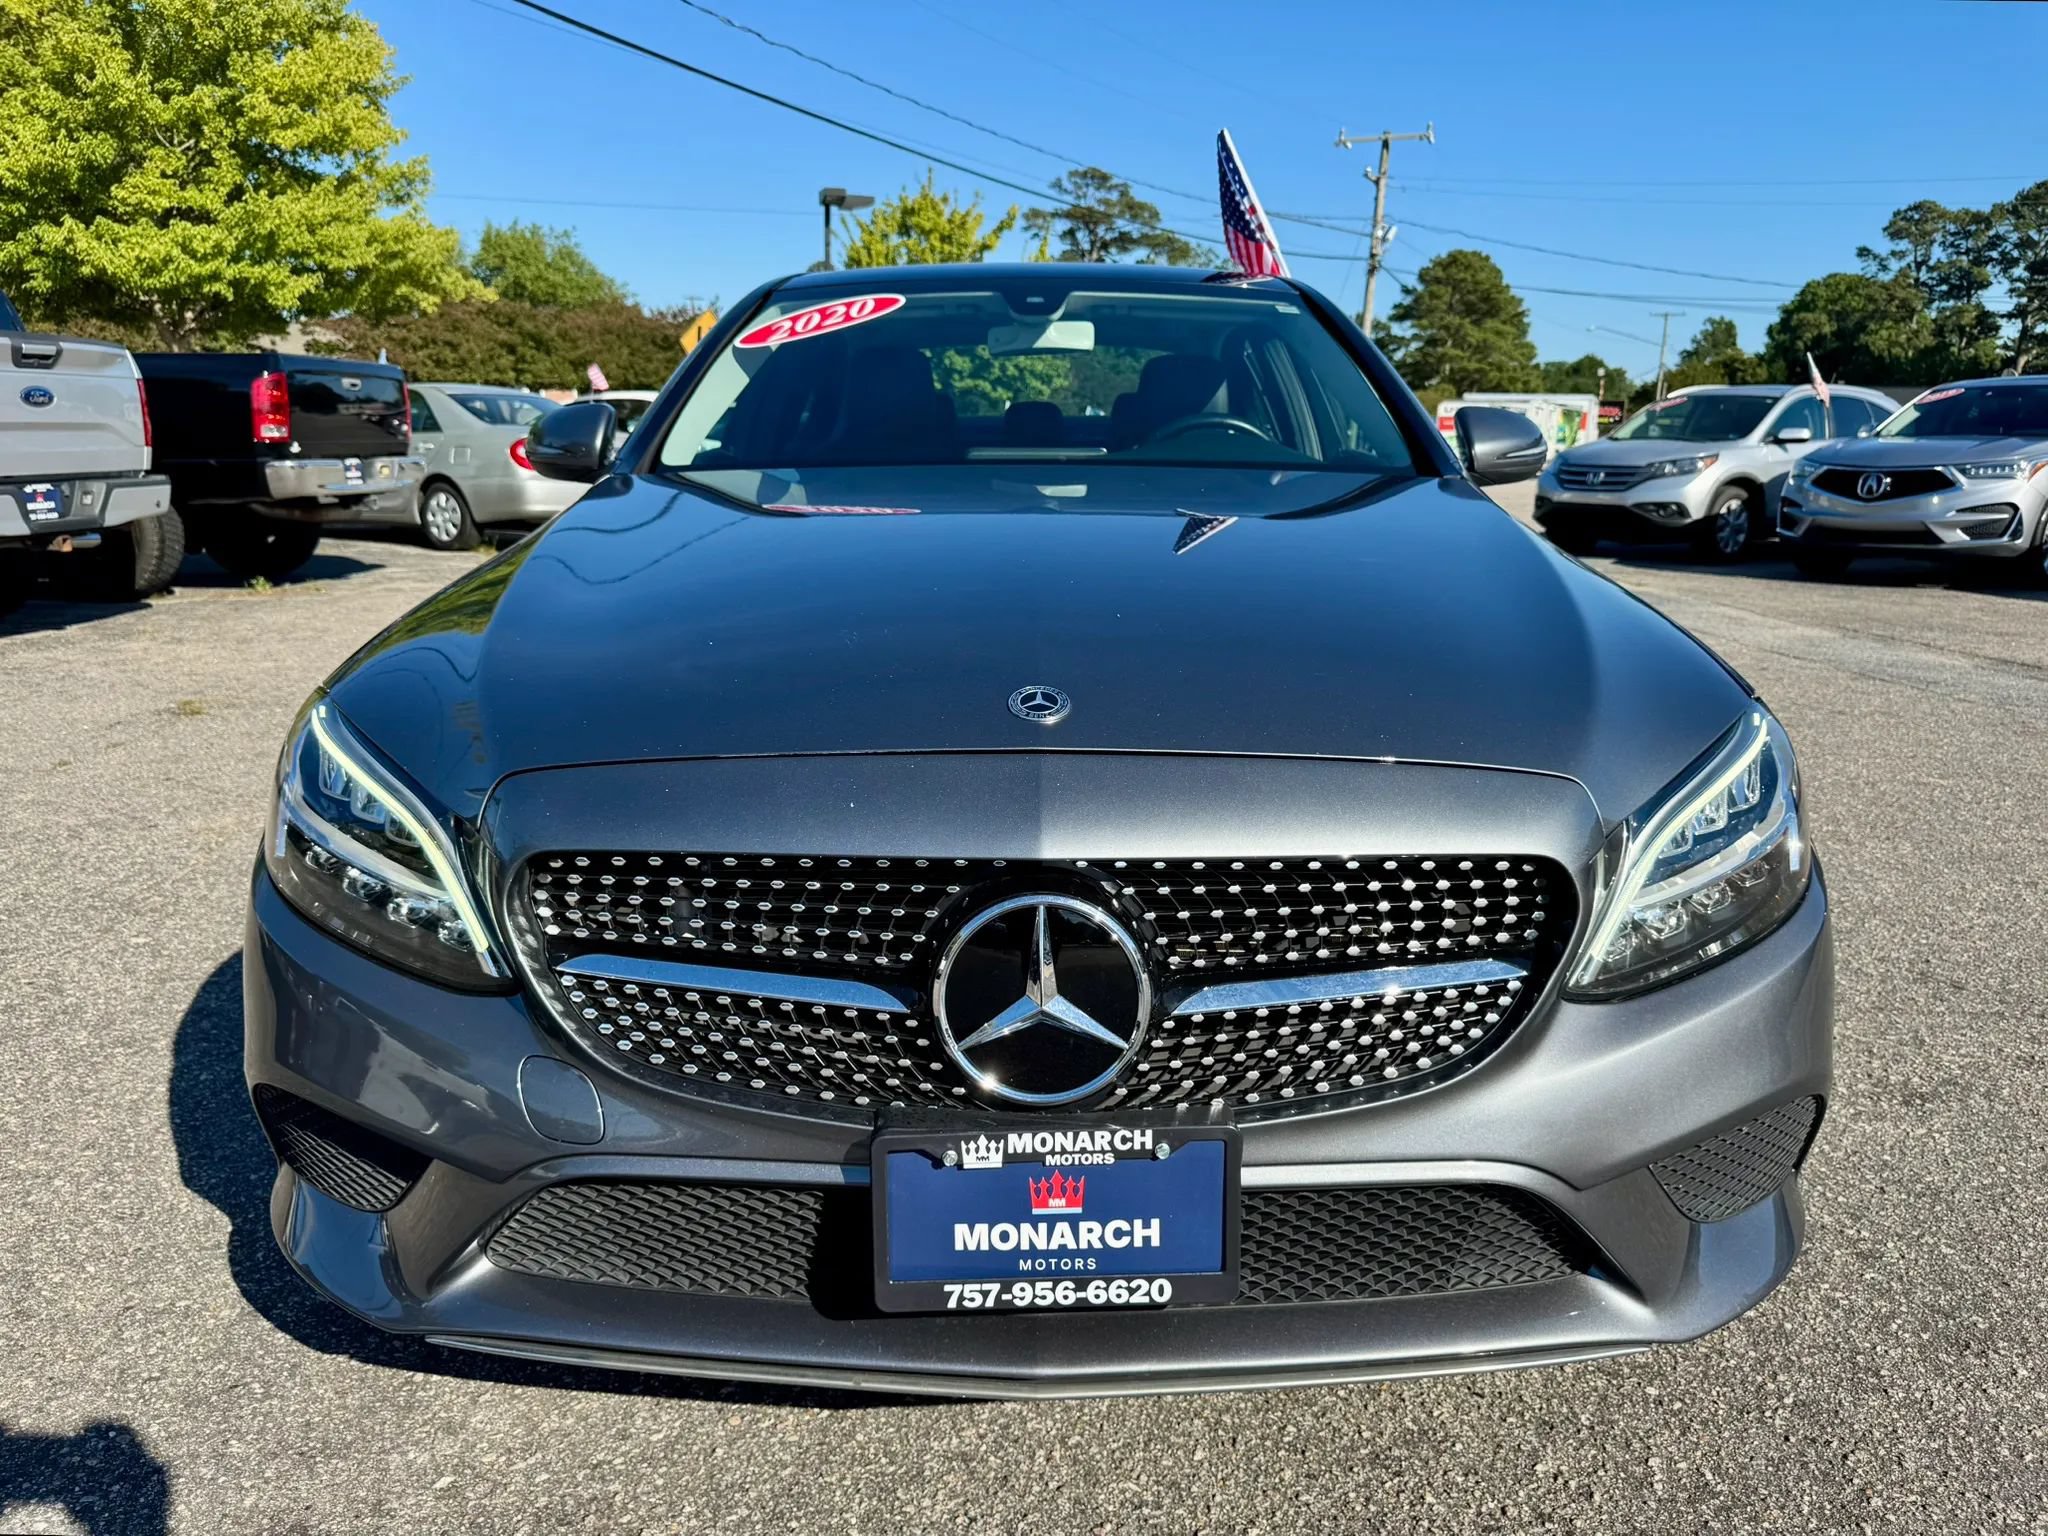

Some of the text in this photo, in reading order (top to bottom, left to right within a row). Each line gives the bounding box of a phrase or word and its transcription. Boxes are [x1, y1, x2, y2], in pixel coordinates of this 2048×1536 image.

[767, 300, 875, 342] 2020
[1008, 1129, 1153, 1154] MONARCH
[1046, 1153, 1115, 1166] MOTORS
[1048, 1197, 1065, 1207] MM
[954, 1218, 1160, 1251] MONARCH
[1019, 1258, 1097, 1271] MOTORS
[943, 1278, 1173, 1308] 757-956-6620
